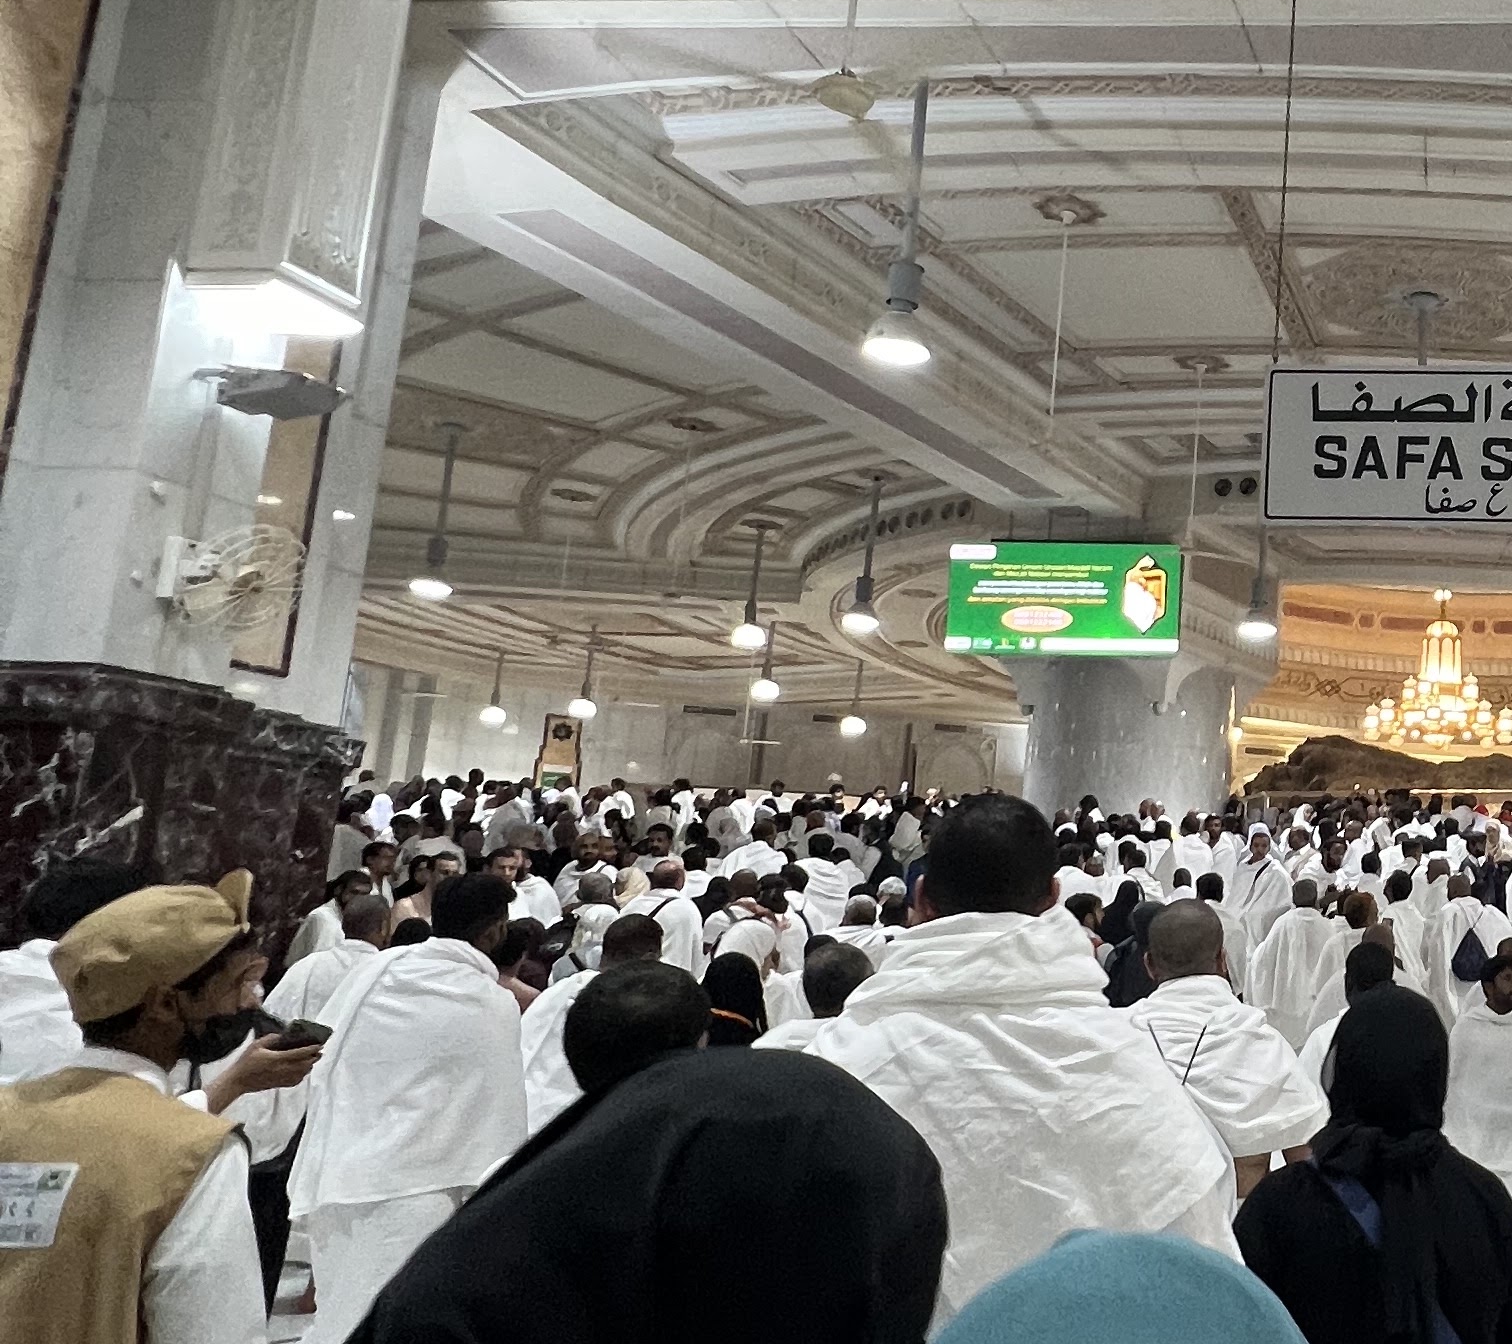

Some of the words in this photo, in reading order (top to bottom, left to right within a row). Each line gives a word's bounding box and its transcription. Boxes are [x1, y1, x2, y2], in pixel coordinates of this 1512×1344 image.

[1311, 380, 1492, 423] الصفا
[1313, 435, 1463, 480] SAFA
[1425, 484, 1477, 514] صفا
